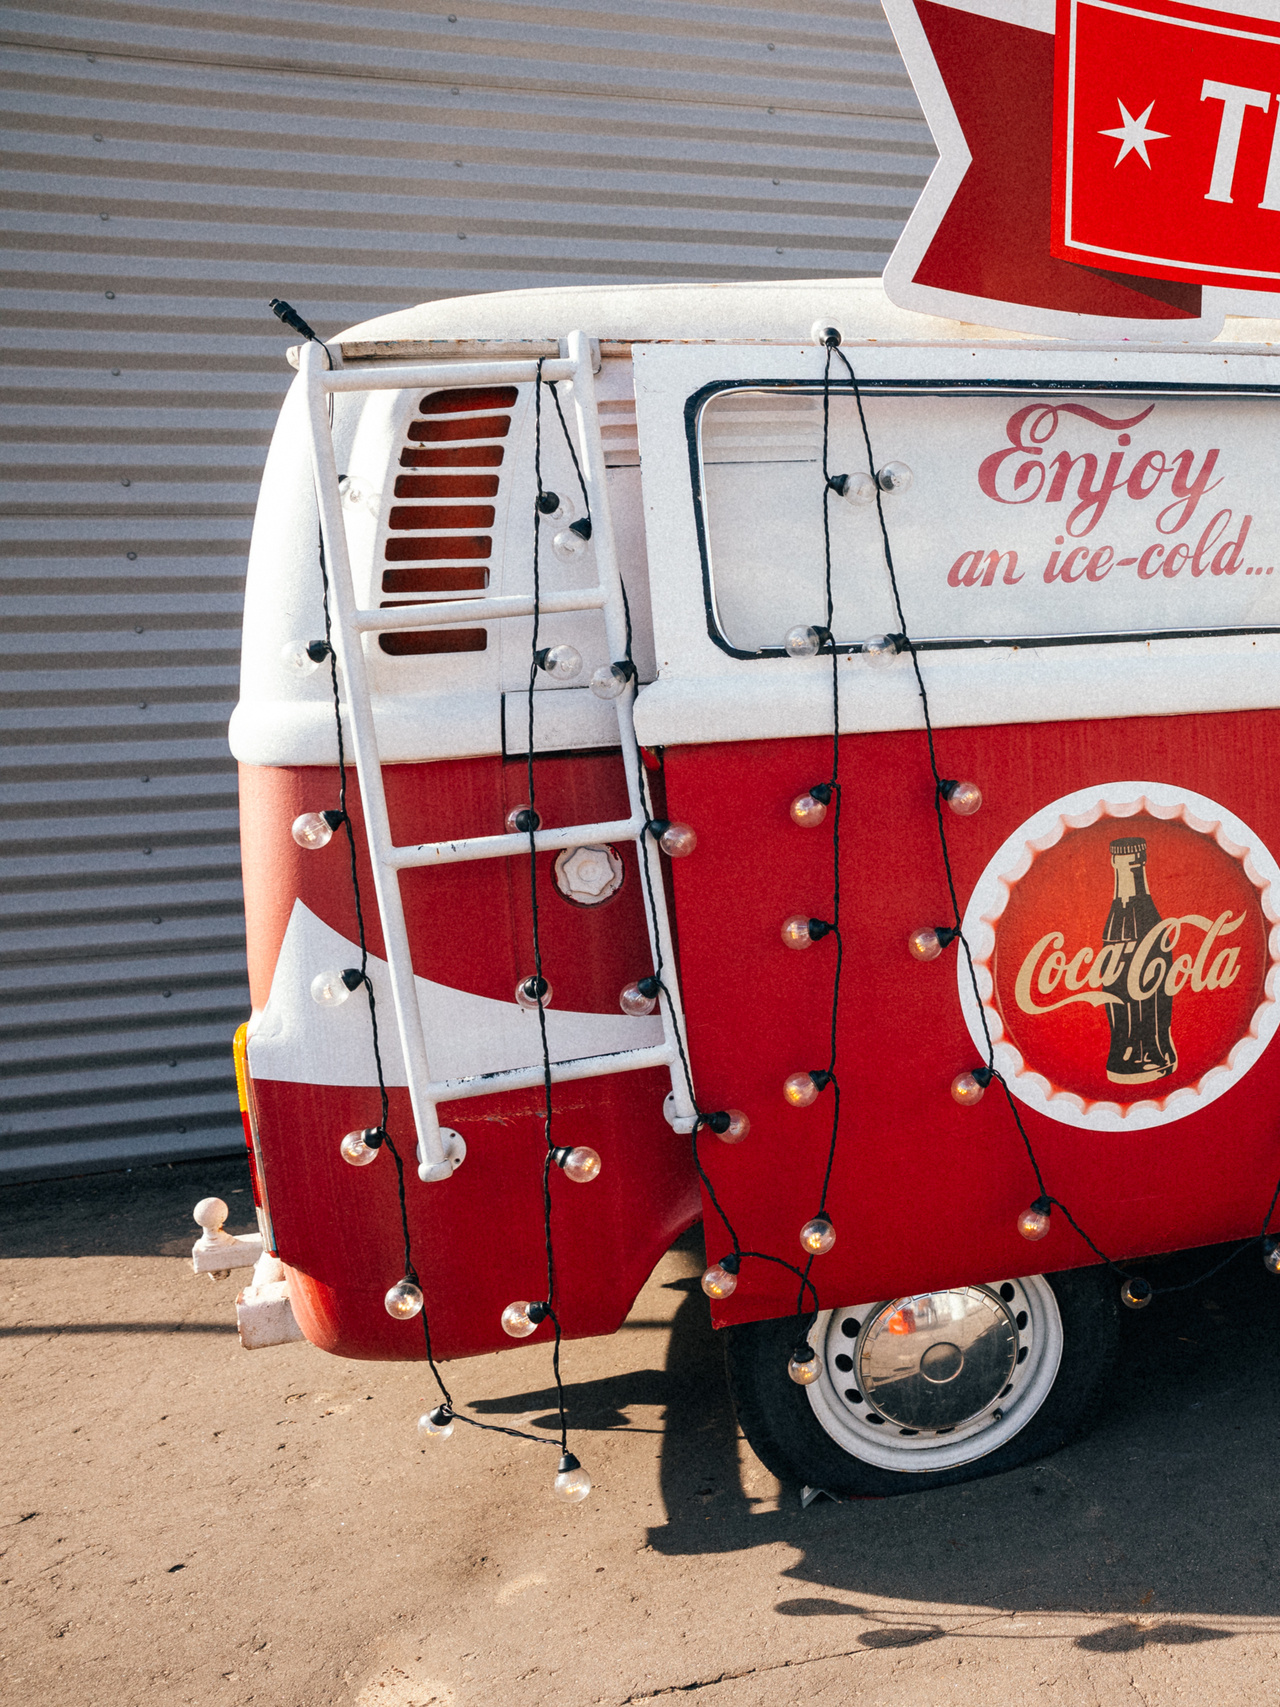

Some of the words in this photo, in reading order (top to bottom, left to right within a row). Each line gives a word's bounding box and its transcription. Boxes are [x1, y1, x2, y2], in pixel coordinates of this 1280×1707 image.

[978, 403, 1225, 538] Enjoy
[947, 549, 1025, 587] an
[1043, 508, 1274, 583] ice-cold...
[1015, 909, 1247, 1015] Coca-Cola
